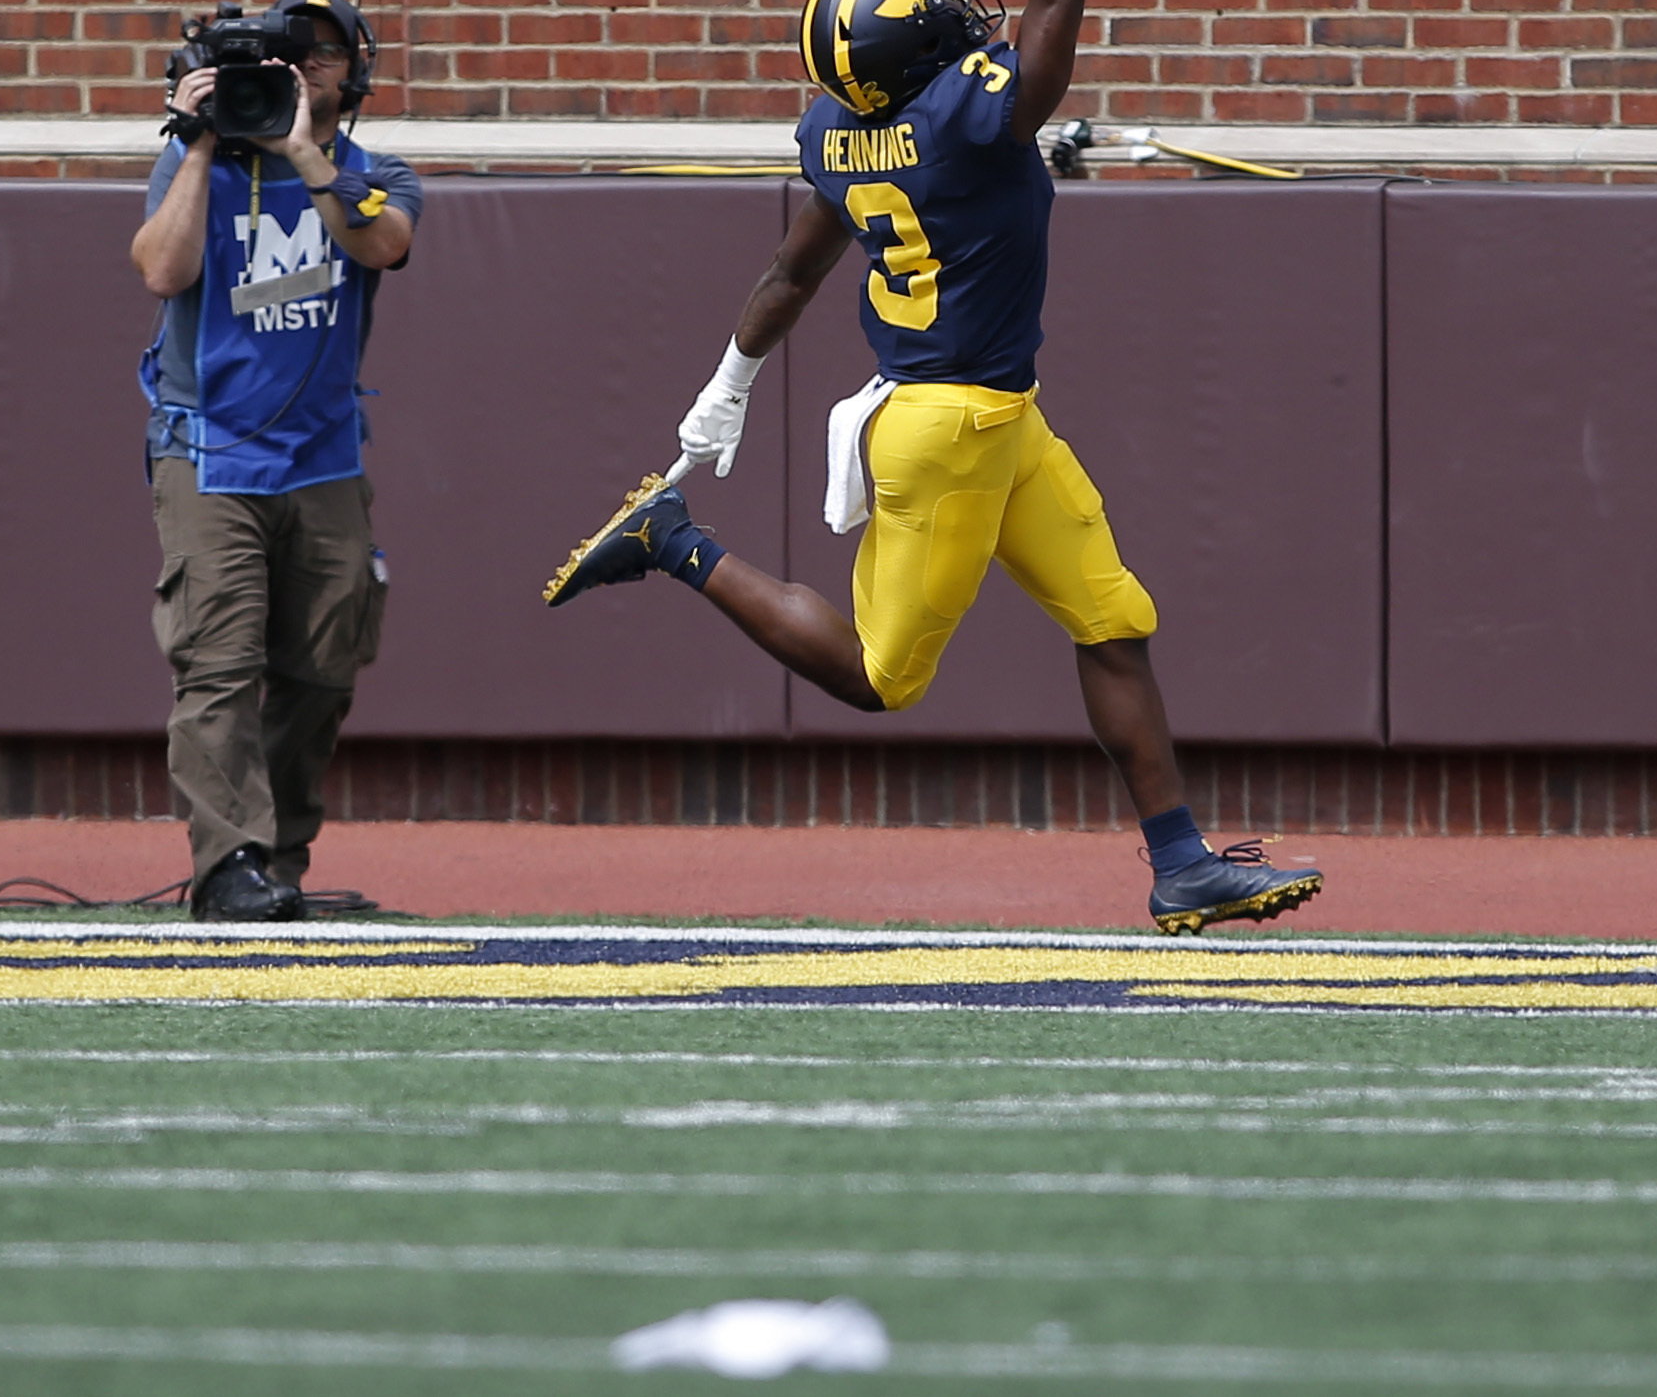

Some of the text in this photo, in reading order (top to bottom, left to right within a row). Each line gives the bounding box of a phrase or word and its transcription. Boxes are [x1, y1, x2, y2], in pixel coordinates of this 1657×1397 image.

[960, 51, 1012, 94] 3
[822, 122, 920, 173] HENNING
[233, 207, 347, 290] M
[845, 181, 942, 332] 3
[252, 299, 339, 333] MSTV
